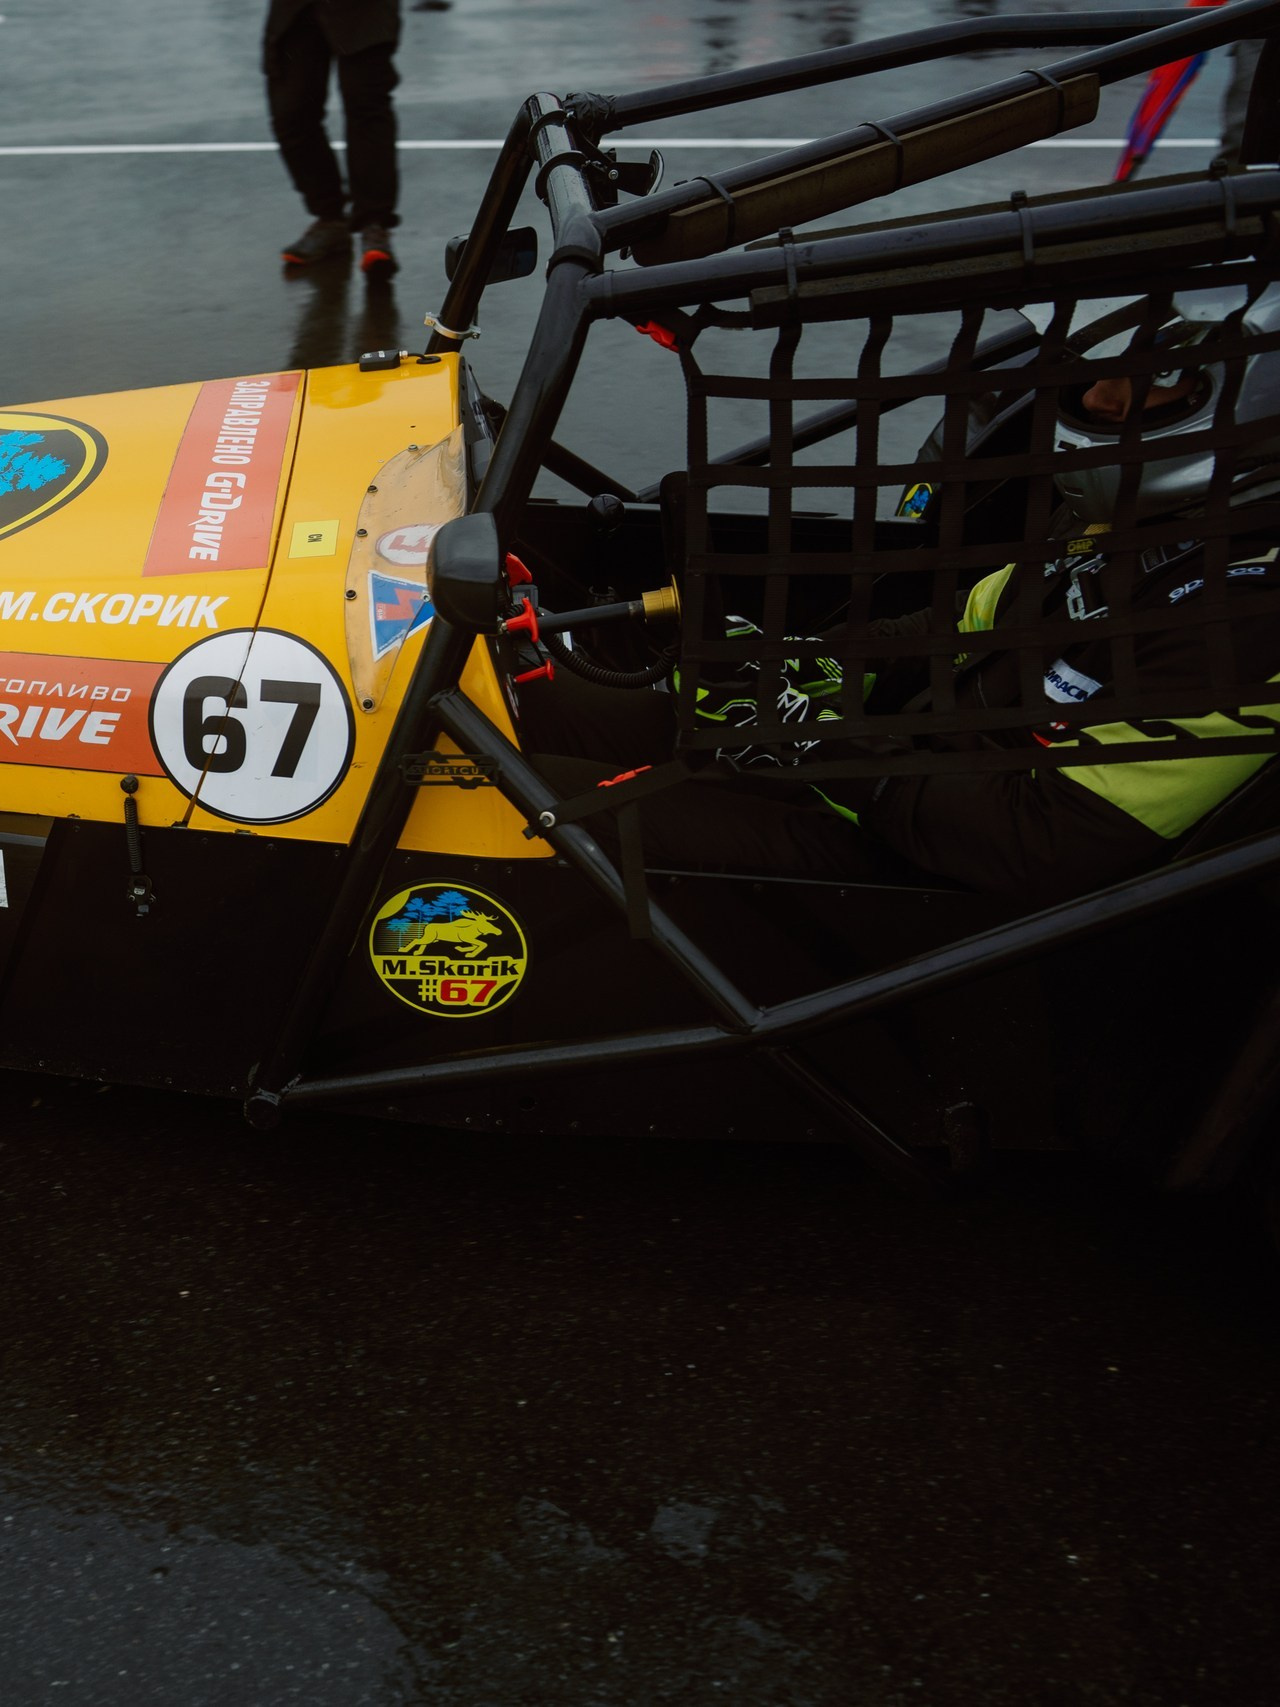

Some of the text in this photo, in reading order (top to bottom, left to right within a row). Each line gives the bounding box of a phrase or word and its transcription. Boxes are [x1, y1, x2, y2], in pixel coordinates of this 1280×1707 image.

[211, 380, 270, 465] ЗАПРАВЛЕНО
[182, 675, 322, 779] 67
[382, 959, 520, 977] M.Skorik
[418, 979, 498, 1003] #67
